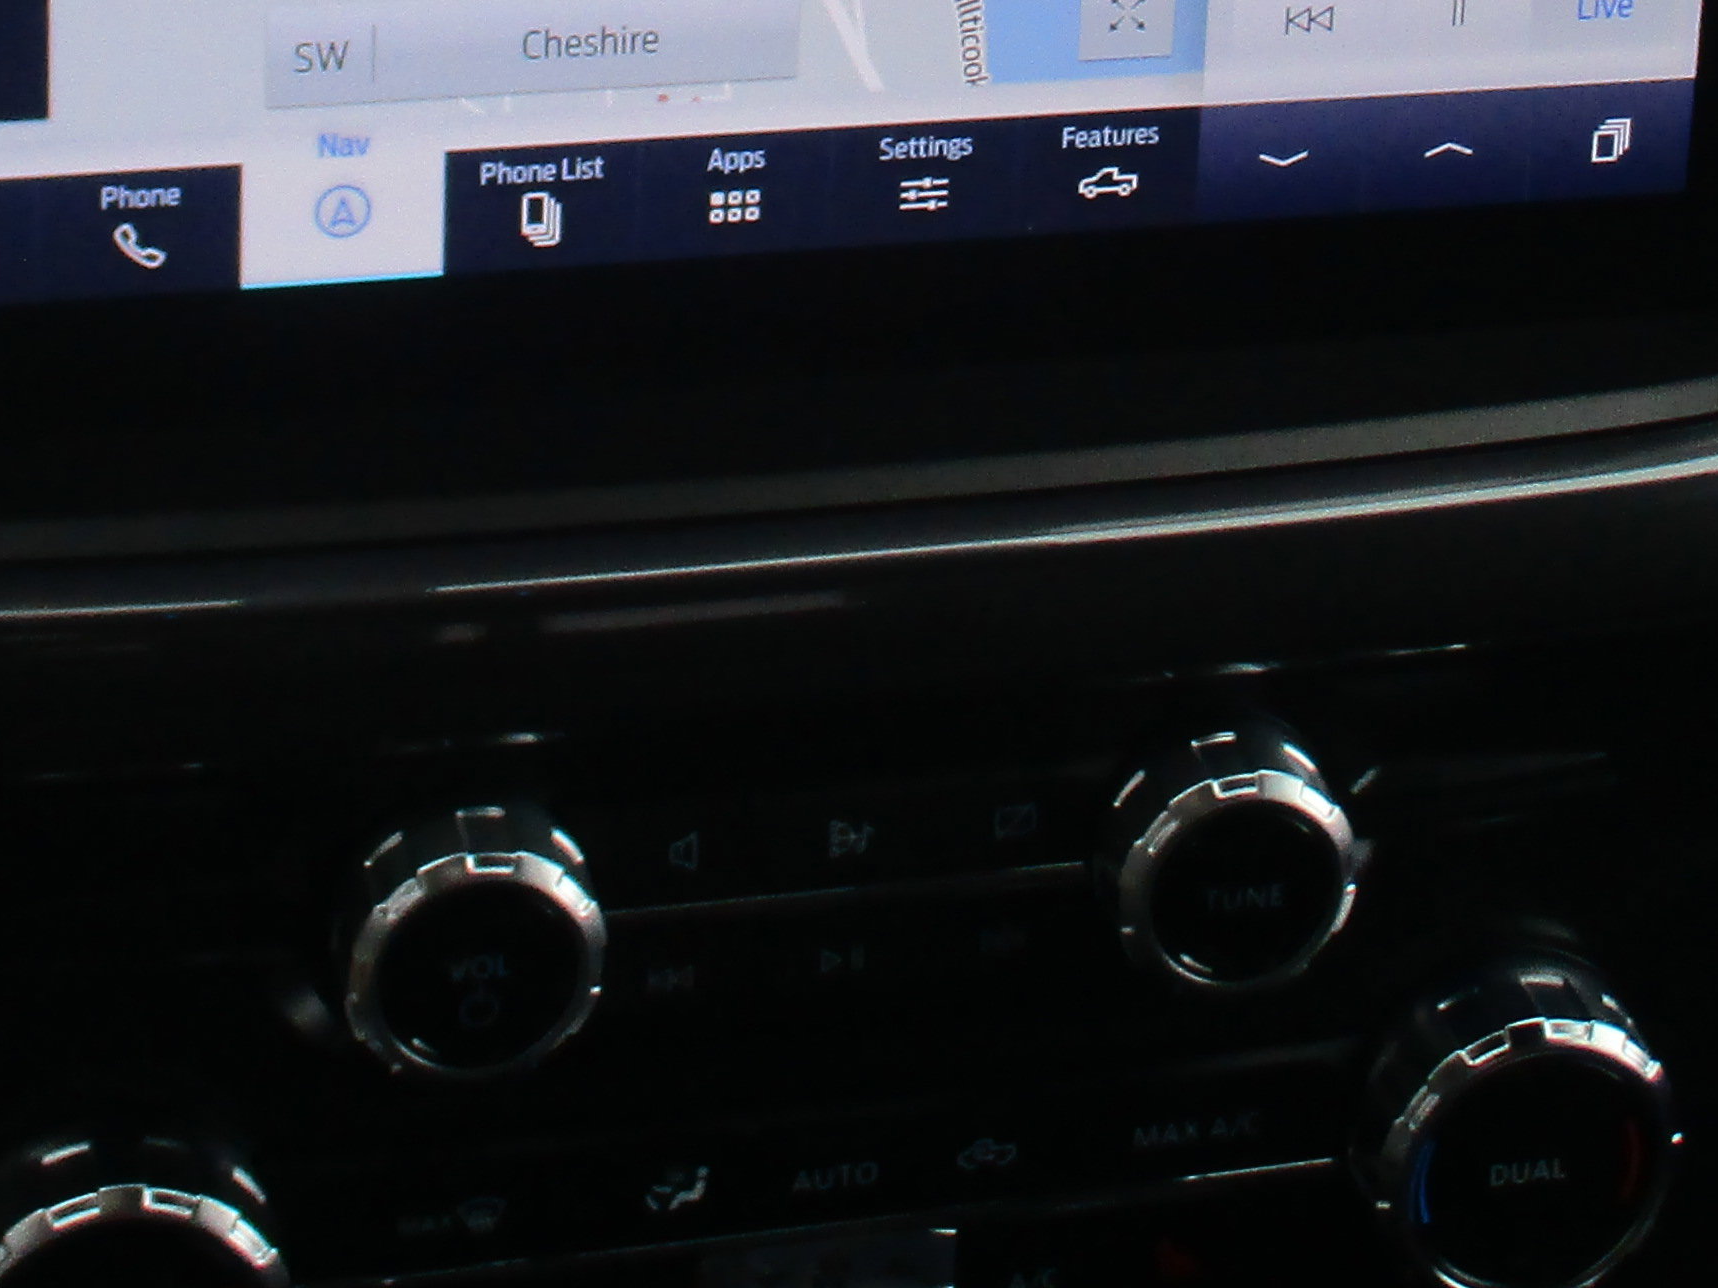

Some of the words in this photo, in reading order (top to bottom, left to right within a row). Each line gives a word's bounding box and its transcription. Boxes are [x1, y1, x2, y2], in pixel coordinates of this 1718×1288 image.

[521, 24, 660, 61] Cheshire
[293, 41, 350, 75] SW
[317, 130, 371, 159] Nav
[879, 132, 974, 165] Settings
[1061, 122, 1160, 151] Features
[479, 158, 556, 185] Phone
[563, 155, 604, 181] List
[707, 145, 766, 175] Apps
[100, 181, 182, 211] Phone
[791, 1160, 880, 1193] AUTO
[1488, 1158, 1569, 1186] DUAL
